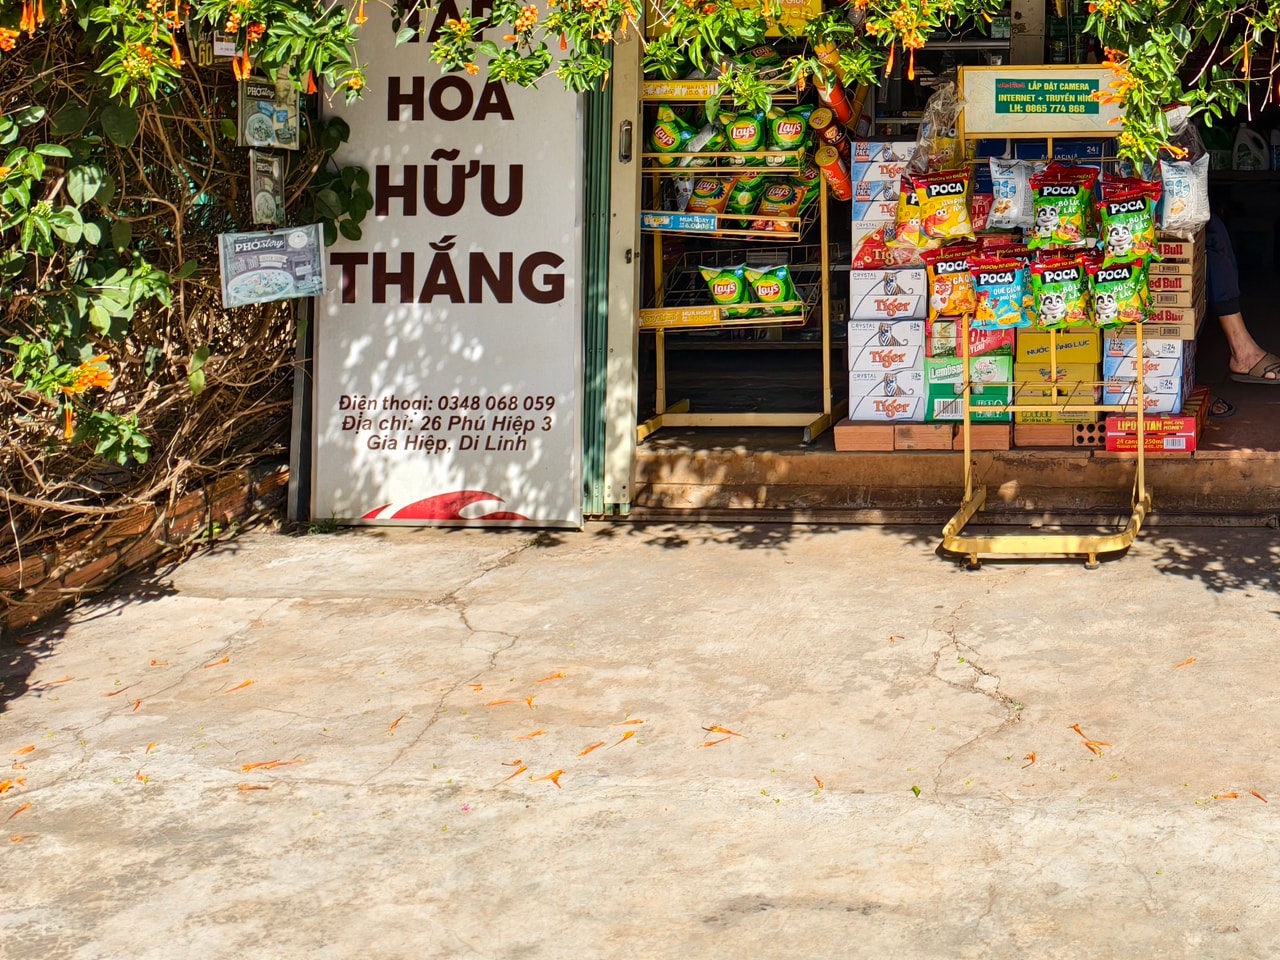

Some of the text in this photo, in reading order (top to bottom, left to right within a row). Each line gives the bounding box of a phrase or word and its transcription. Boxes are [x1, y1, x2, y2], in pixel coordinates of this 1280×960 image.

[1059, 83, 1090, 91] CAMERA
[998, 94, 1036, 102] INTERNET
[1009, 104, 1085, 112] LH: 0865 774 868
[375, 148, 524, 217] HỮU
[929, 183, 964, 196] POCA
[1042, 186, 1077, 196] POCA
[1110, 200, 1144, 214] POCA
[1164, 244, 1183, 255] Bull
[329, 234, 566, 304] THẮNG
[937, 260, 969, 274] POCA
[980, 272, 1014, 285] POCA
[1044, 269, 1078, 283] POCA
[1097, 268, 1130, 282] POCA
[1163, 277, 1182, 288] Bull
[874, 297, 911, 317] Tiger
[869, 349, 907, 368] Tiger
[1131, 359, 1160, 375] Tger
[339, 395, 556, 415] Điện thoại: 0348 068 059
[873, 398, 910, 418] Tiger
[342, 414, 552, 436] Địa chỉ: 26 Phú Hiệp 3
[1117, 420, 1162, 431] LIPOITAN
[367, 434, 528, 454] Gia Hiệp, Di Linh
